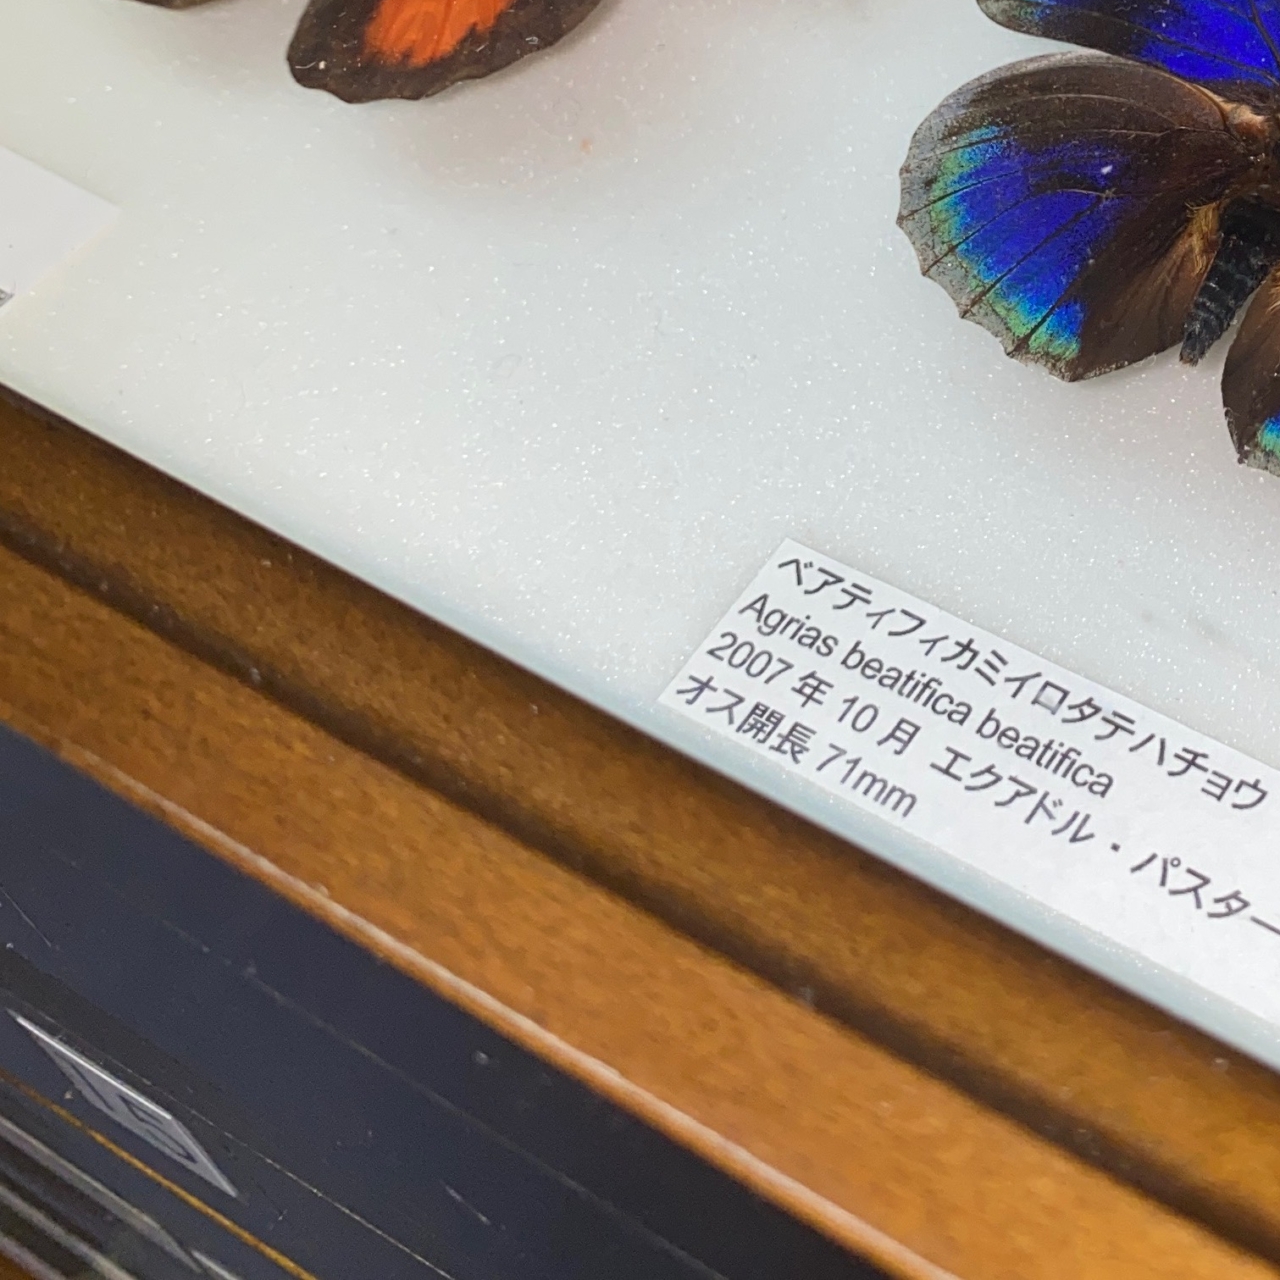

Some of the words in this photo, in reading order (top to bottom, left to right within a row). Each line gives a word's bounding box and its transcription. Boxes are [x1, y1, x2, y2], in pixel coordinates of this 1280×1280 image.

[738, 593, 839, 657] Agrias
[840, 640, 973, 726] beatifica
[976, 708, 1114, 798] beatifica
[777, 557, 1268, 811] ベアティフィカミイロタテハチョウ
